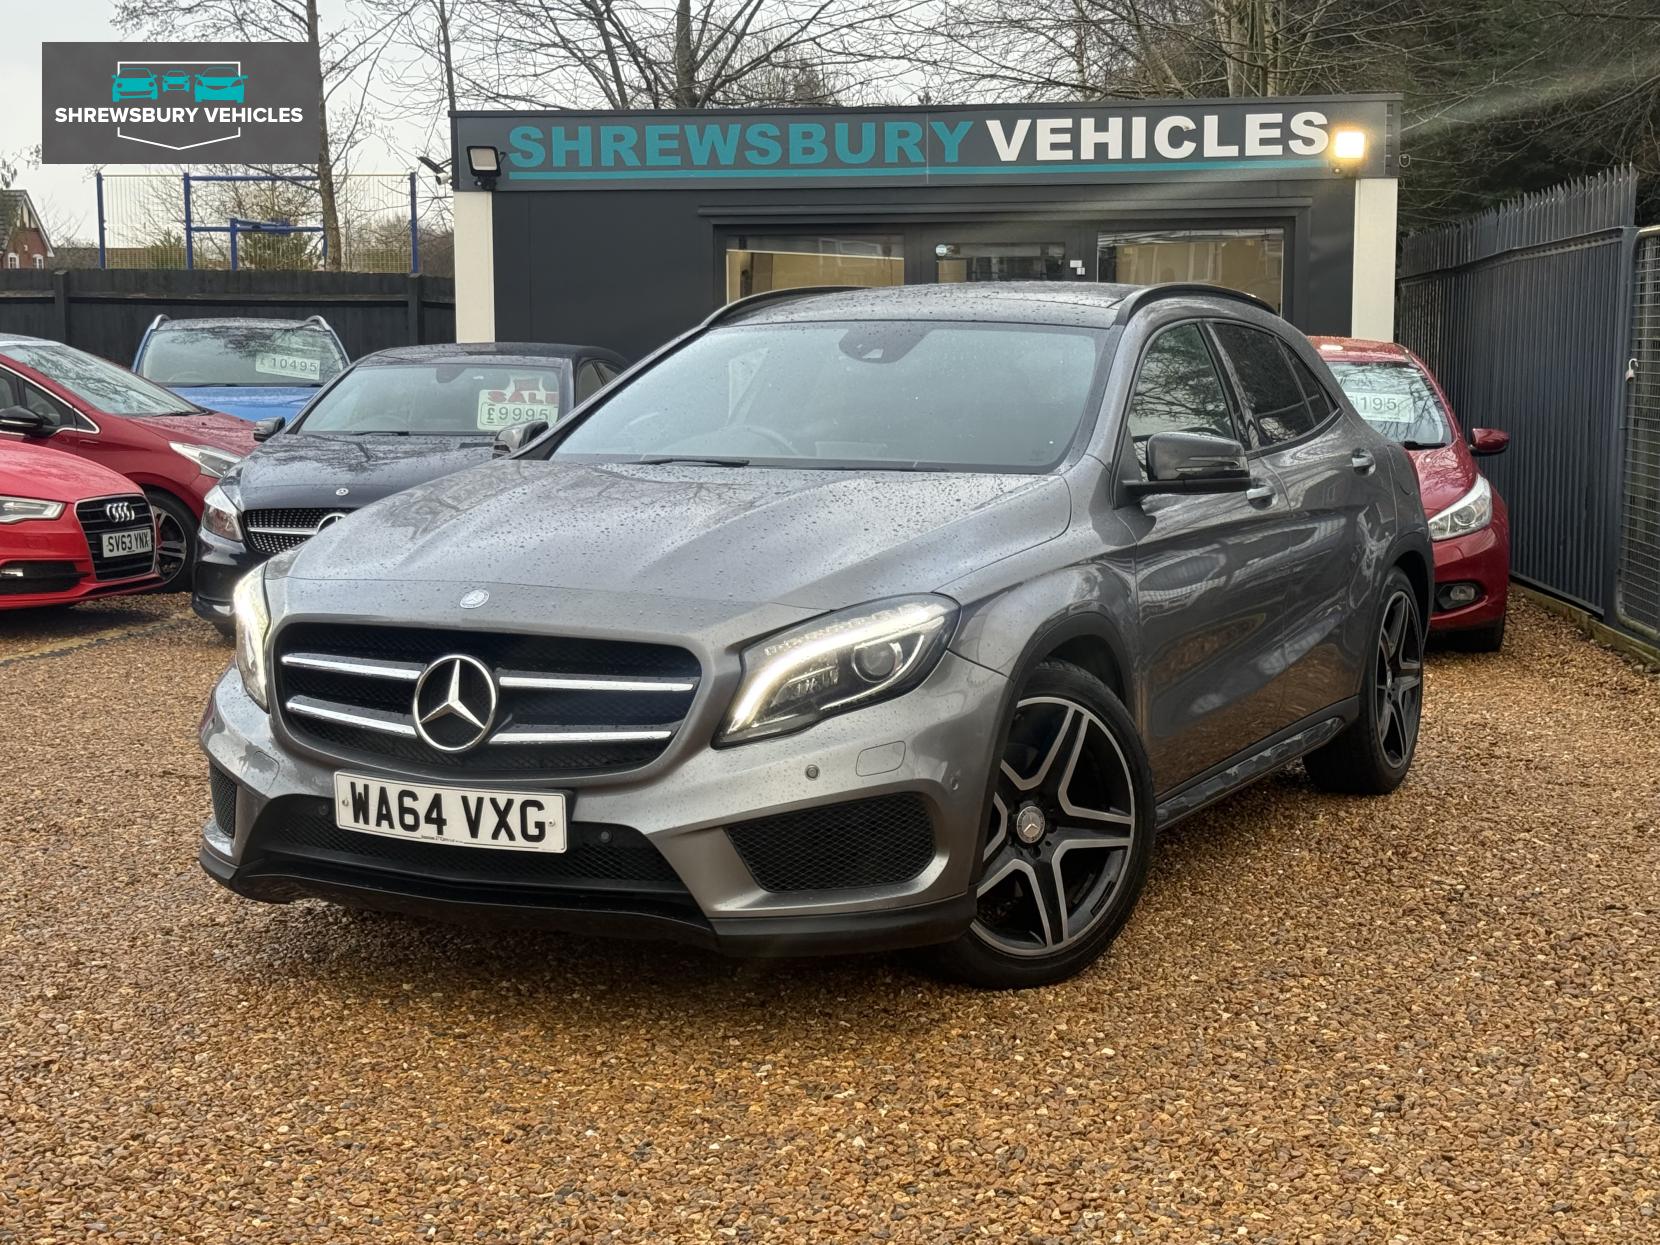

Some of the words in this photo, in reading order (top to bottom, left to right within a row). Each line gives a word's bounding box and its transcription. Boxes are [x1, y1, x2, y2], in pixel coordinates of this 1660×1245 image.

[508, 120, 974, 168] SHREWSBURY
[985, 111, 1329, 161] VEHICLES
[487, 403, 549, 423] £9995
[107, 533, 133, 553] SV63
[133, 531, 149, 550] YNX
[350, 781, 448, 836] WA64
[460, 795, 546, 843] VXG
